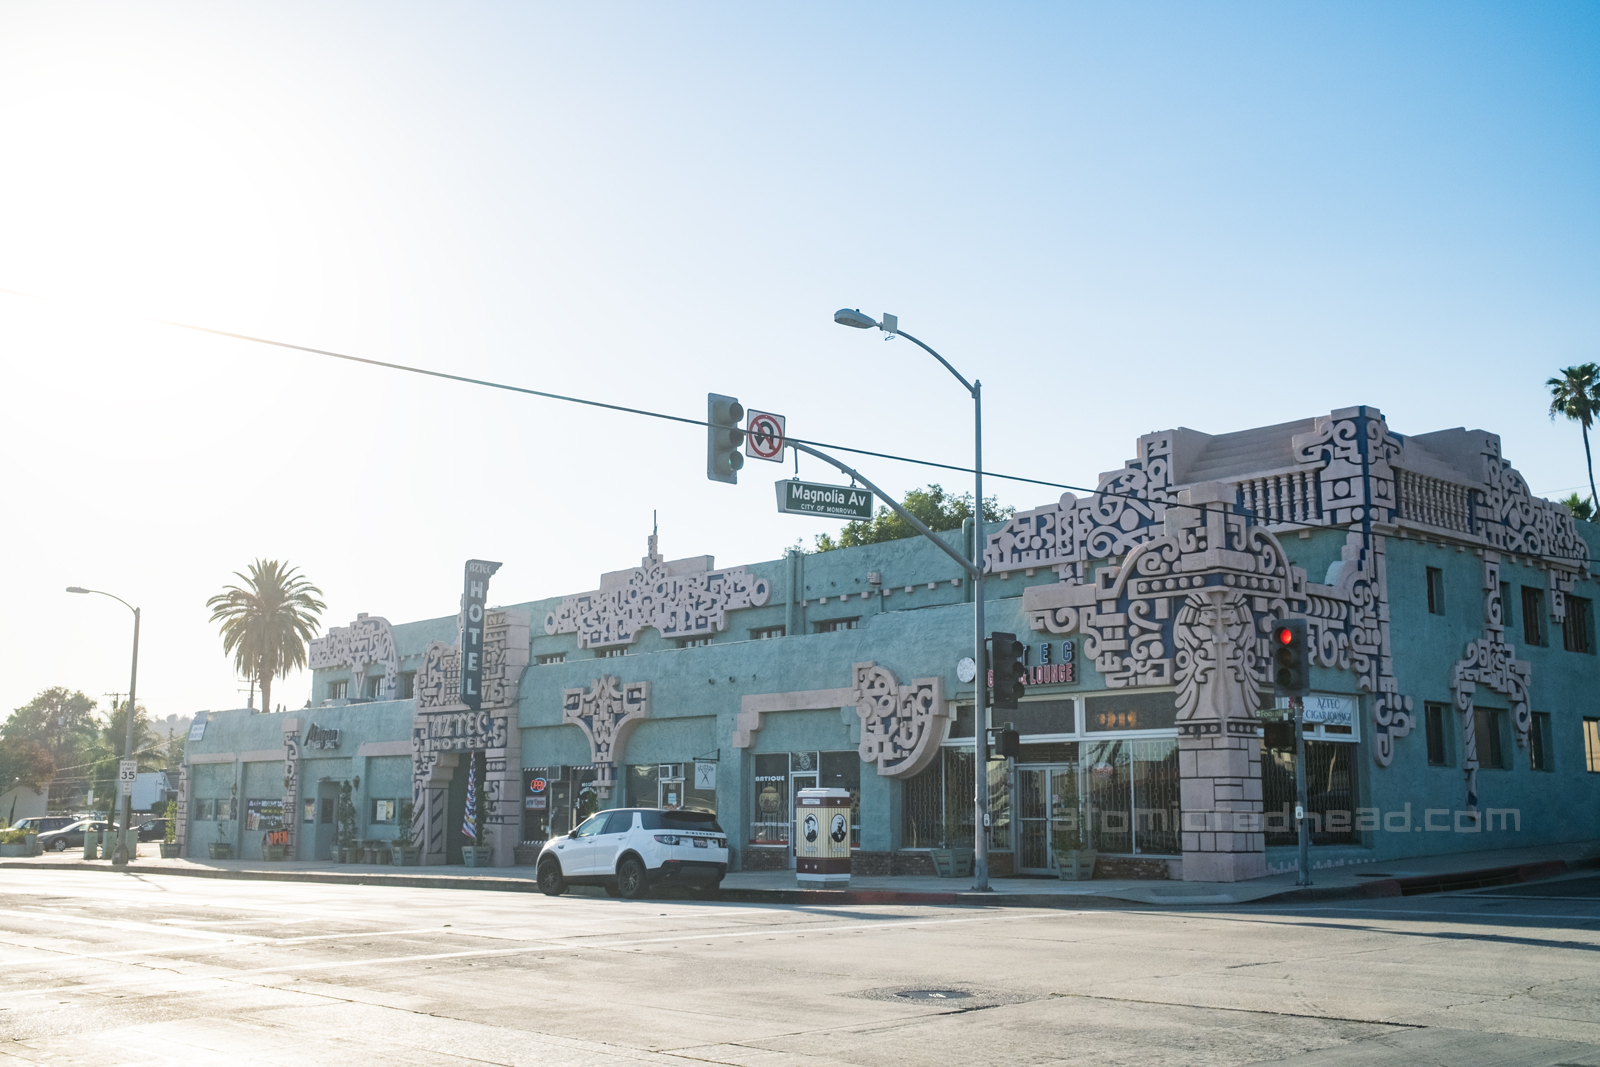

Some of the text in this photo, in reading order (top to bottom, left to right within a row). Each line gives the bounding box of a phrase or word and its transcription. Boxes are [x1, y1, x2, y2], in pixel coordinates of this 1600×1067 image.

[792, 485, 865, 506] Magnolia Av
[827, 507, 857, 515] MONROVIA
[469, 562, 492, 575] AZTEC
[466, 580, 483, 696] HOTEL
[1029, 662, 1073, 685] LOUNGE
[1317, 697, 1340, 710] AZTEC
[1305, 709, 1328, 720] CIGAR
[429, 711, 487, 738] AZTEC
[430, 736, 486, 751] HOTEL
[121, 771, 135, 780] 35
[269, 831, 288, 844] OPEN
